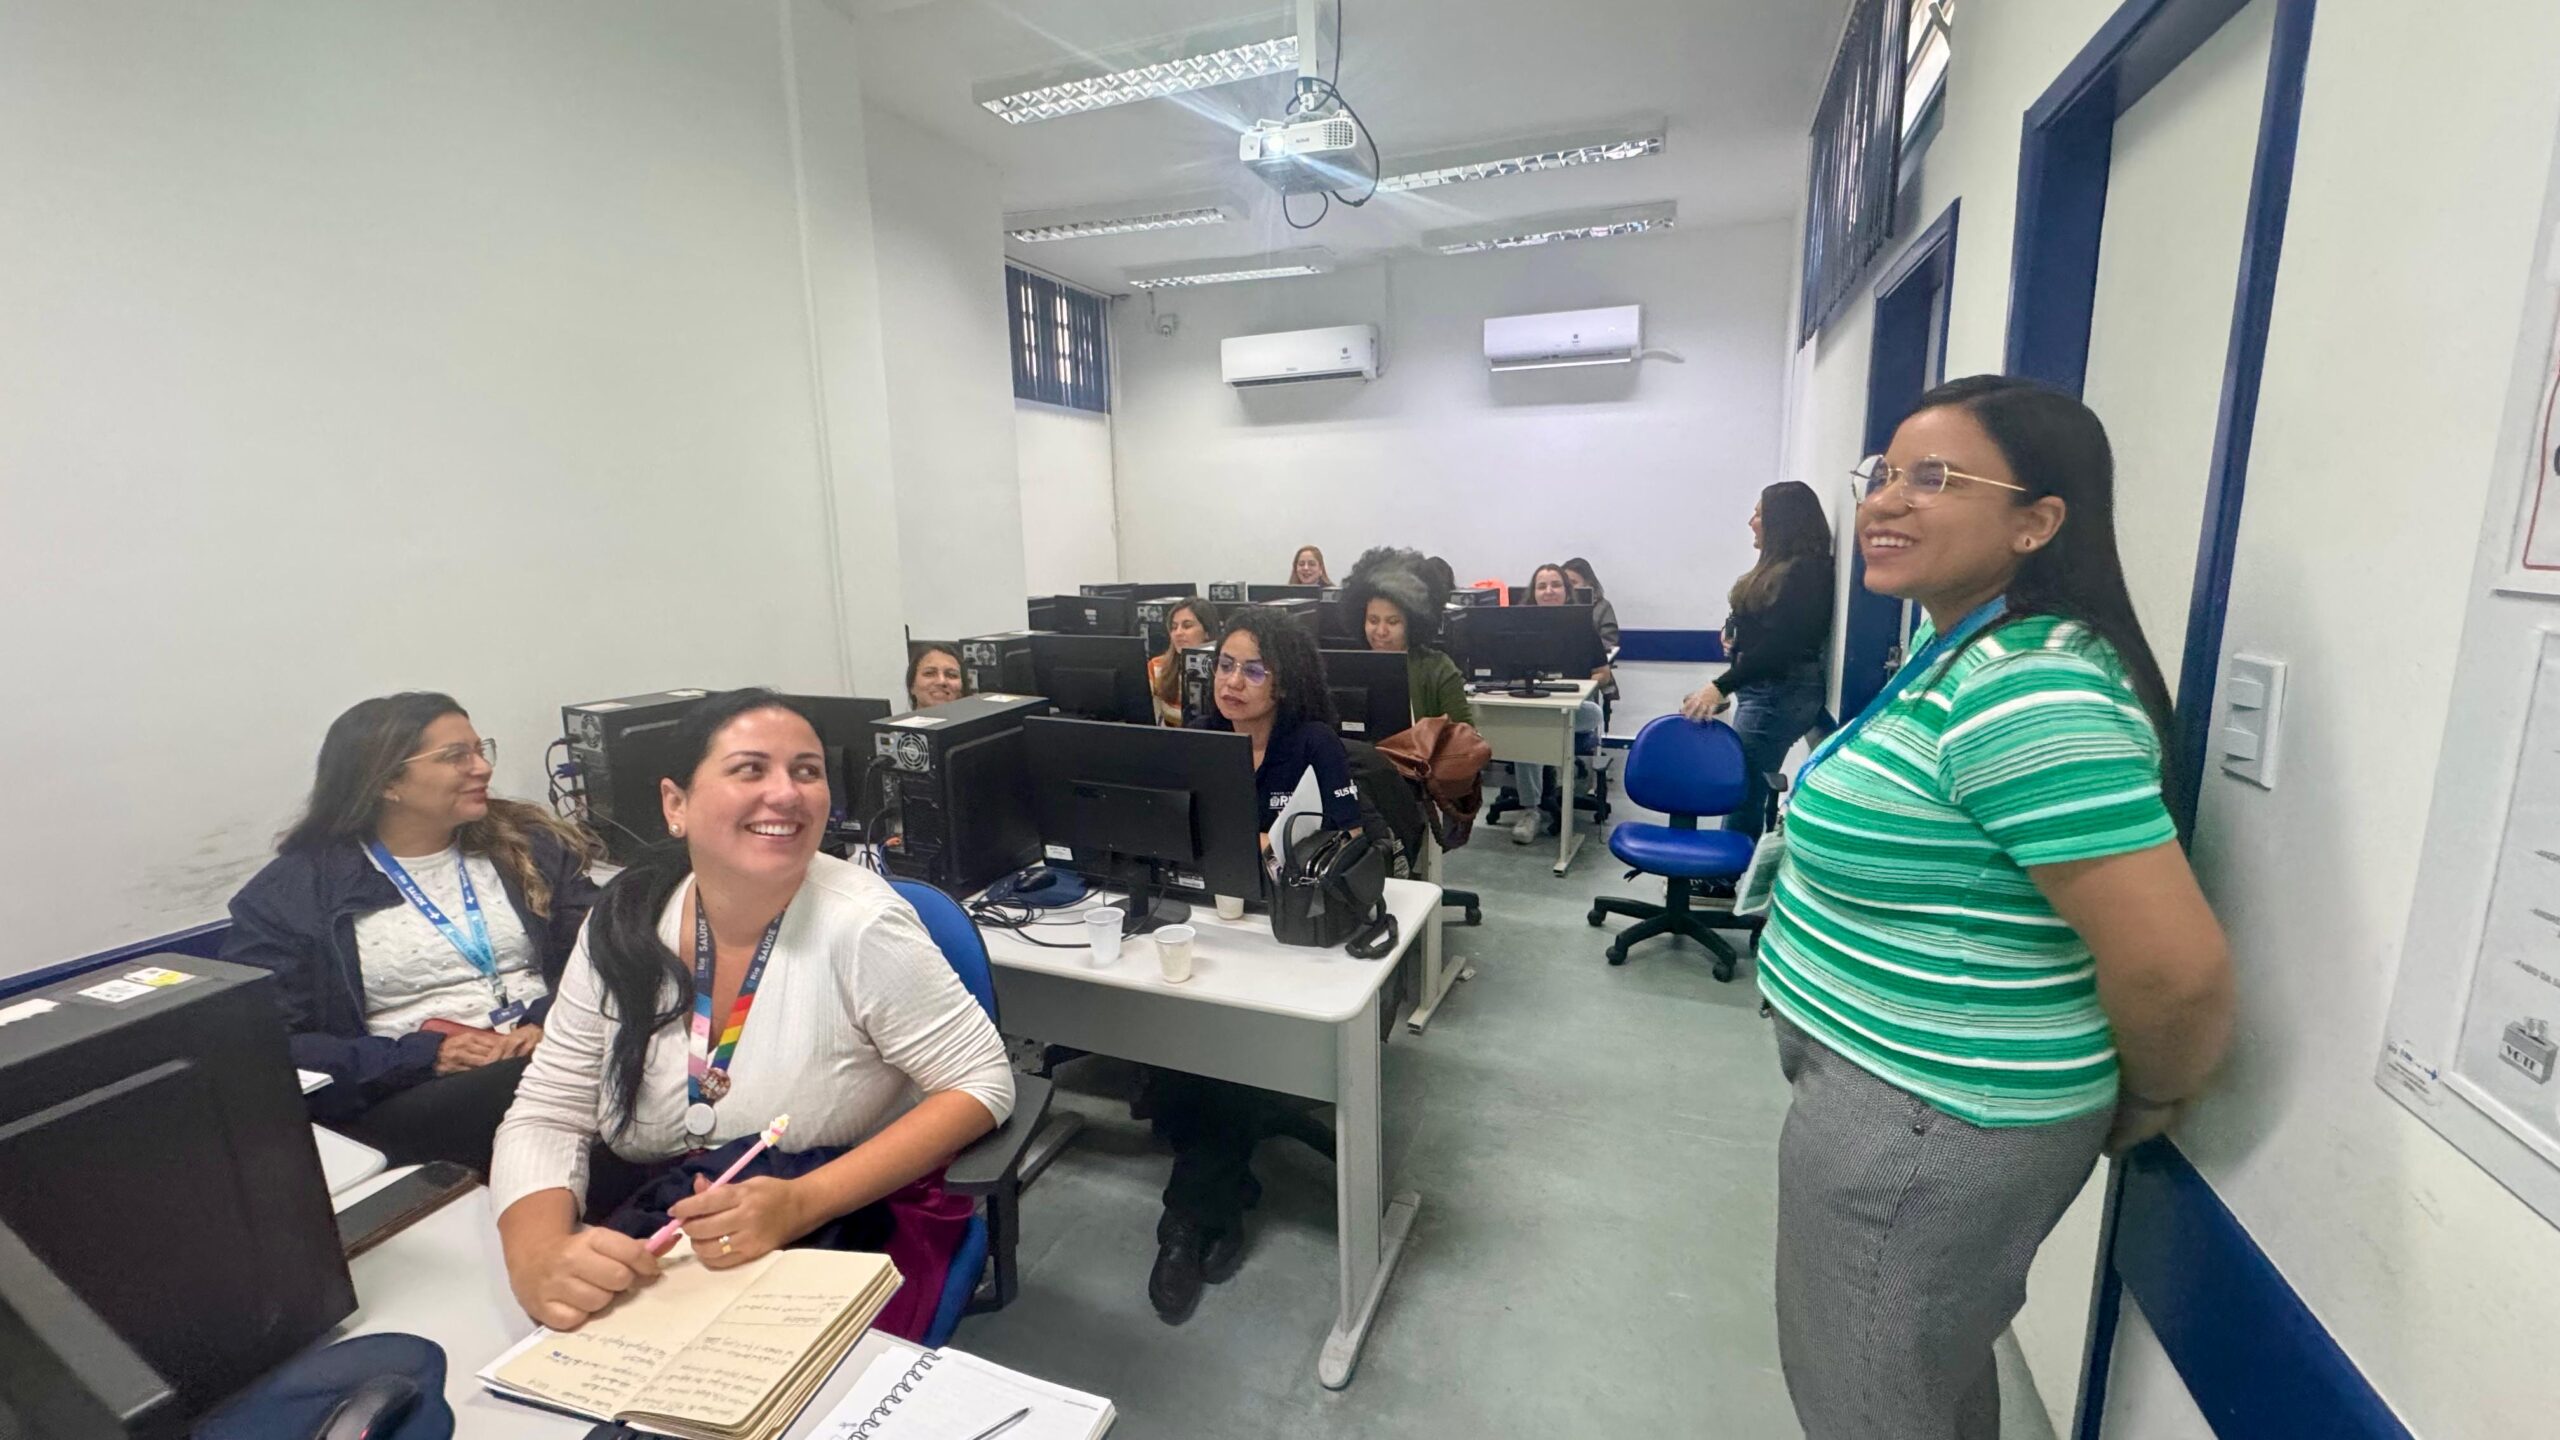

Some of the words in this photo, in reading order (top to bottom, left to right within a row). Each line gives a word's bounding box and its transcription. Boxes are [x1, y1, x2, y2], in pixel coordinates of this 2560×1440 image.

[698, 918, 709, 952] SAÚDE
[758, 928, 777, 962] SAÚDE
[2506, 1044, 2537, 1071] VOTE
